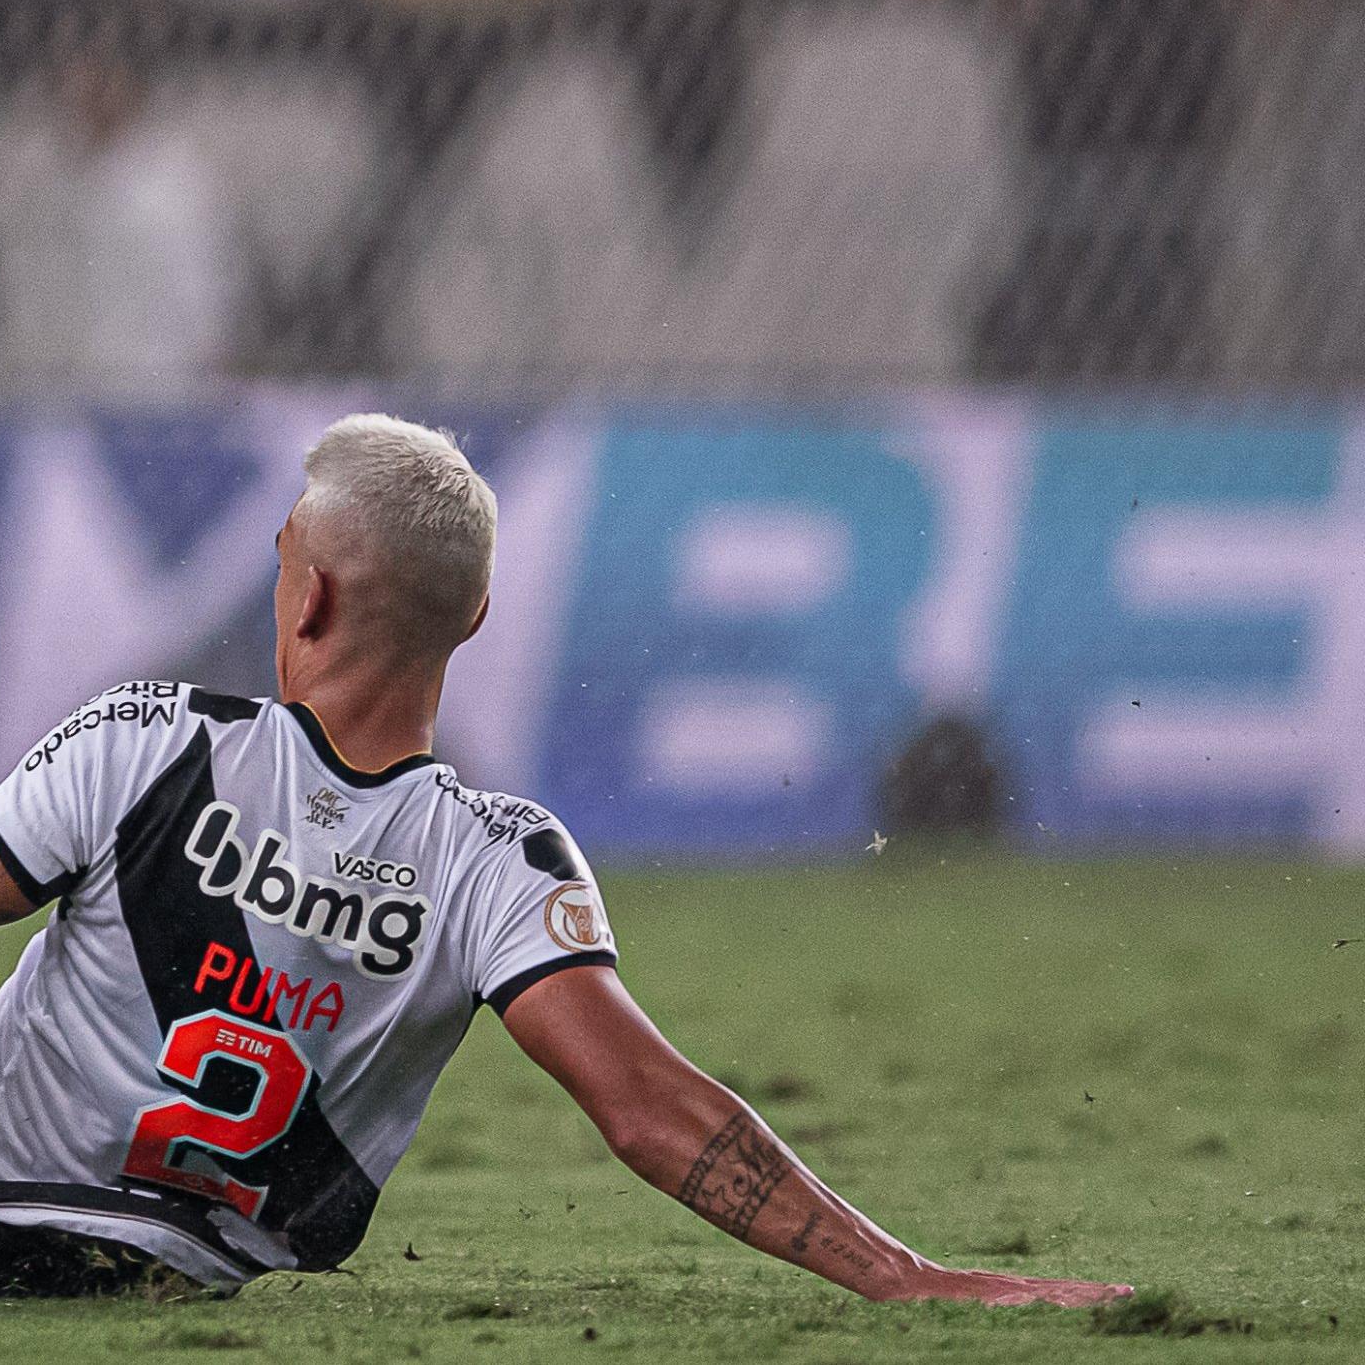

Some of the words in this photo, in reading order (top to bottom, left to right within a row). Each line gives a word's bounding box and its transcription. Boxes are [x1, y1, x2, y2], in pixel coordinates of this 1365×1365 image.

[25, 701, 177, 772] Mercado
[241, 836, 427, 976] bmg
[334, 852, 417, 887] VASCO
[193, 941, 346, 1033] PUMA
[236, 1035, 274, 1059] TIM
[121, 1008, 313, 1222] 2
